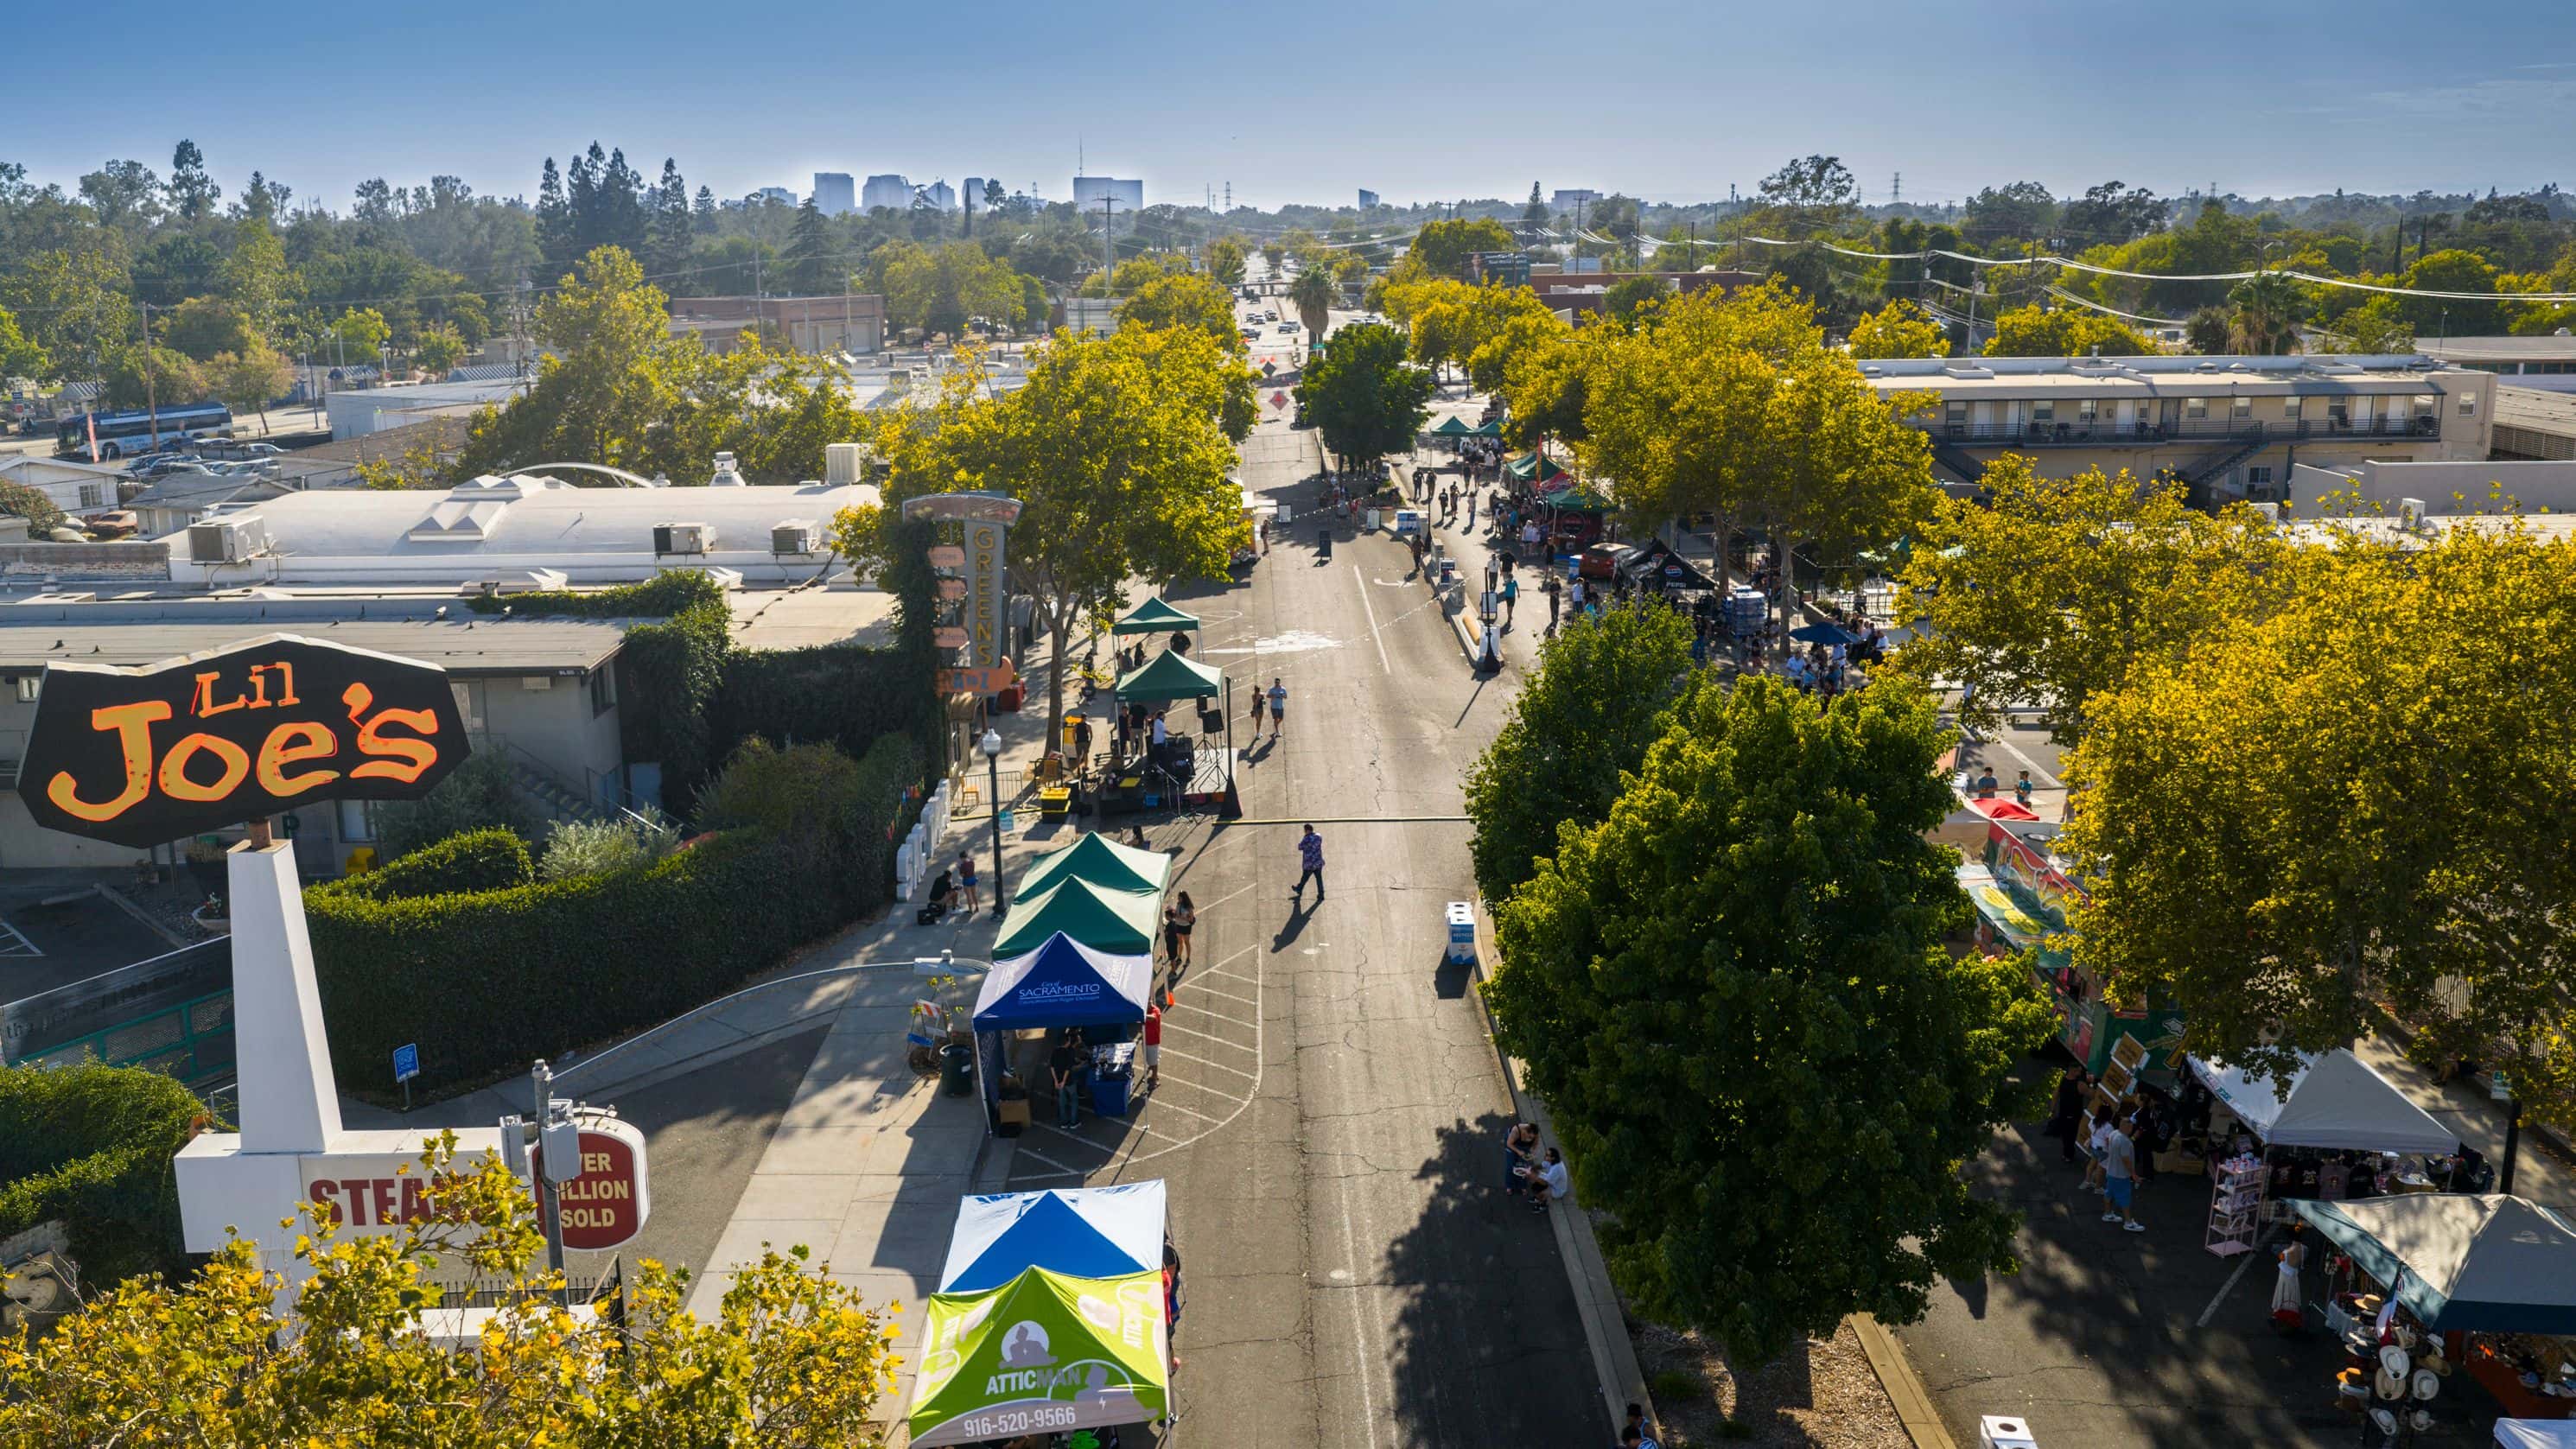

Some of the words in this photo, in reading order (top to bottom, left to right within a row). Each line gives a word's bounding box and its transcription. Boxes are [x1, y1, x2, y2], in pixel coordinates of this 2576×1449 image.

[974, 526, 995, 665] GREENS
[191, 663, 301, 718] Lil
[47, 683, 438, 822] Joe's
[1019, 983, 1100, 997] SACRAMENTO
[579, 1152, 613, 1173] ER
[559, 1179, 629, 1201] ILLION
[562, 1208, 615, 1229] SOLD
[964, 1407, 1076, 1438] 916-520-9566
